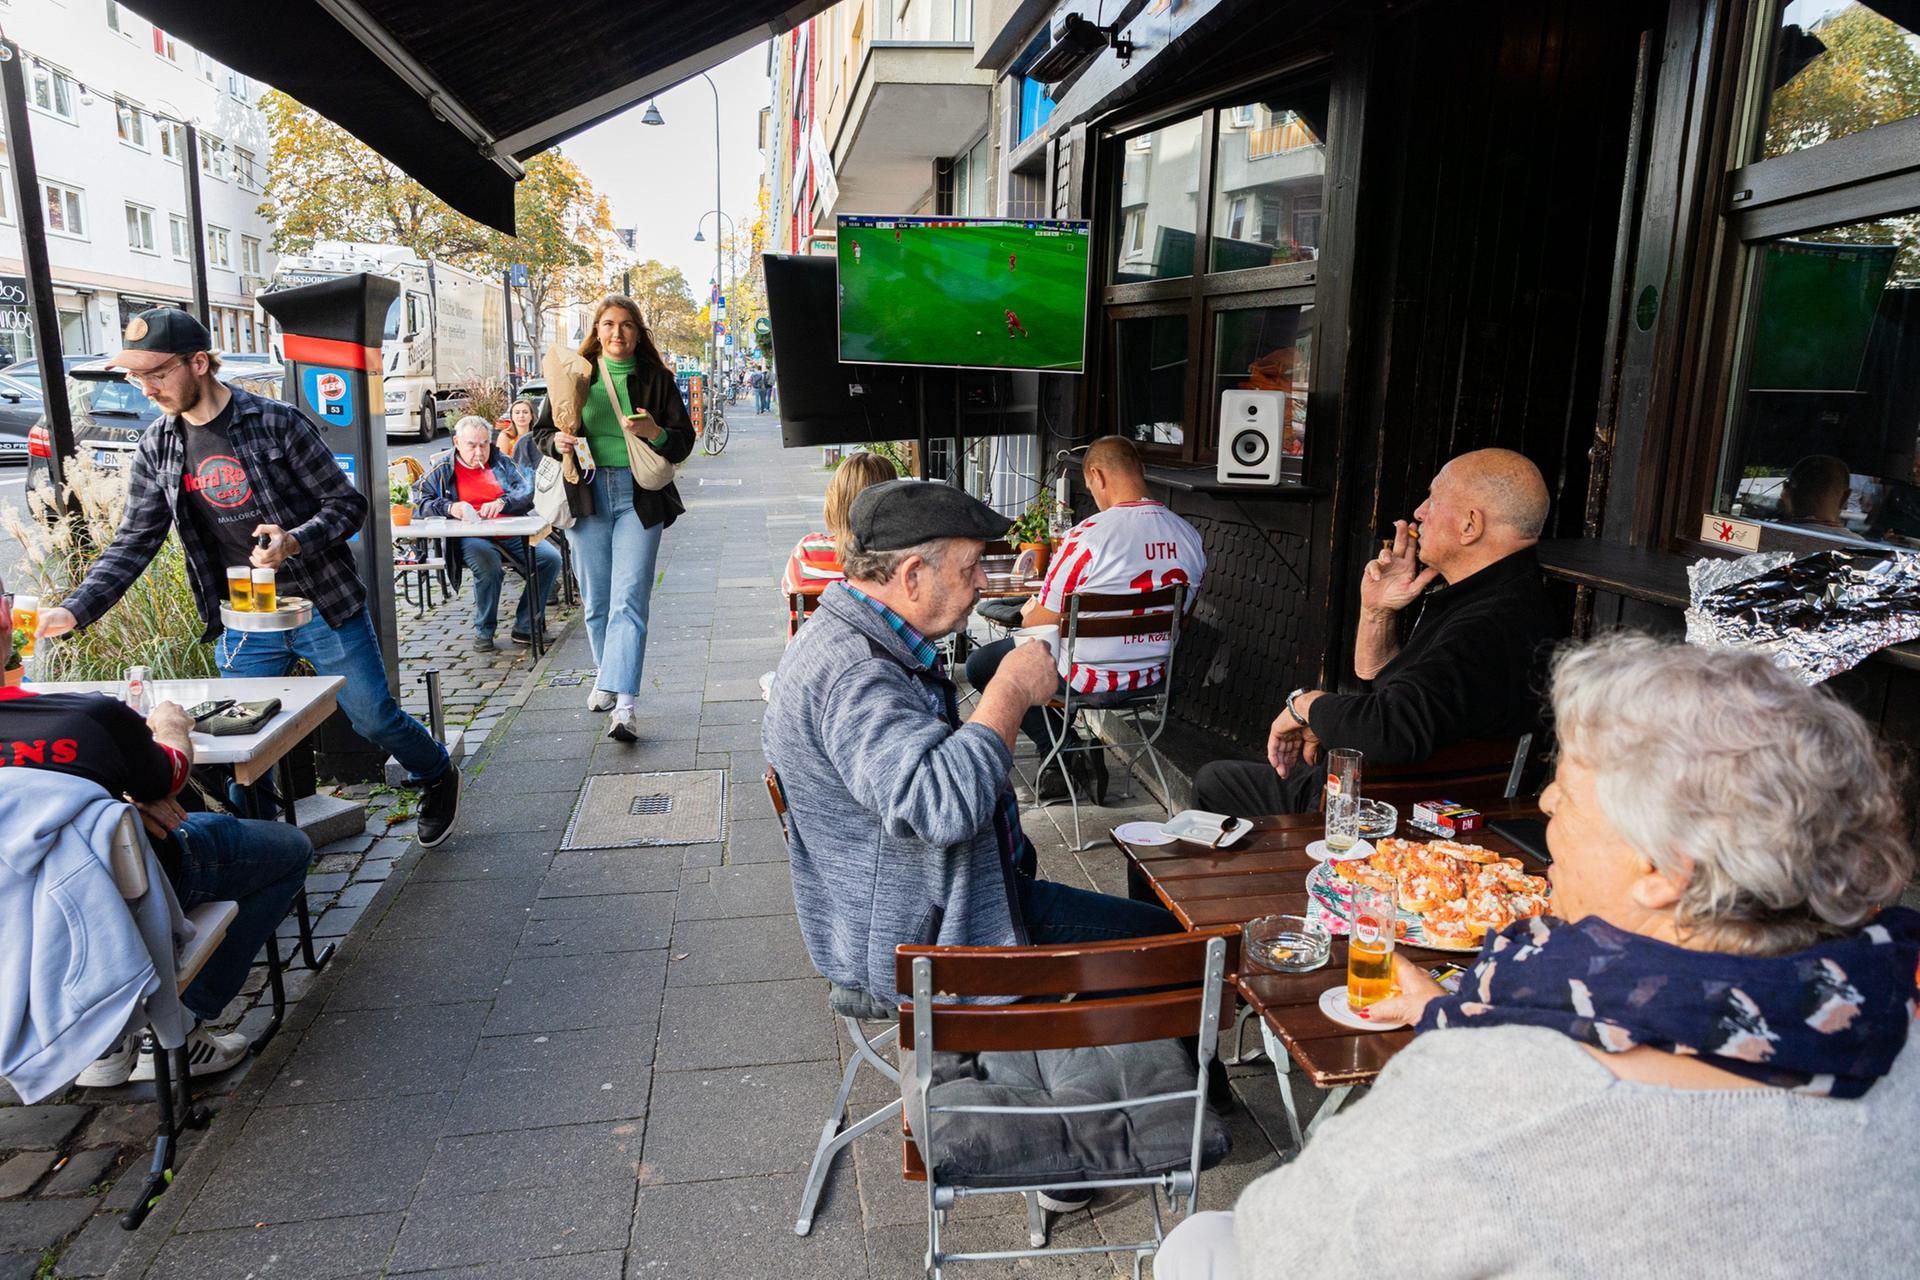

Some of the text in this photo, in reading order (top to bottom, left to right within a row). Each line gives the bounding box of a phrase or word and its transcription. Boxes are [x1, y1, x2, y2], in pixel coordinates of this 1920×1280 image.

[331, 405, 340, 413] 53
[182, 463, 247, 493] Hard Ro
[217, 509, 262, 525] MALLORCA
[1144, 542, 1177, 561] UTH
[1131, 633, 1144, 644] FC
[0, 739, 80, 768] NS
